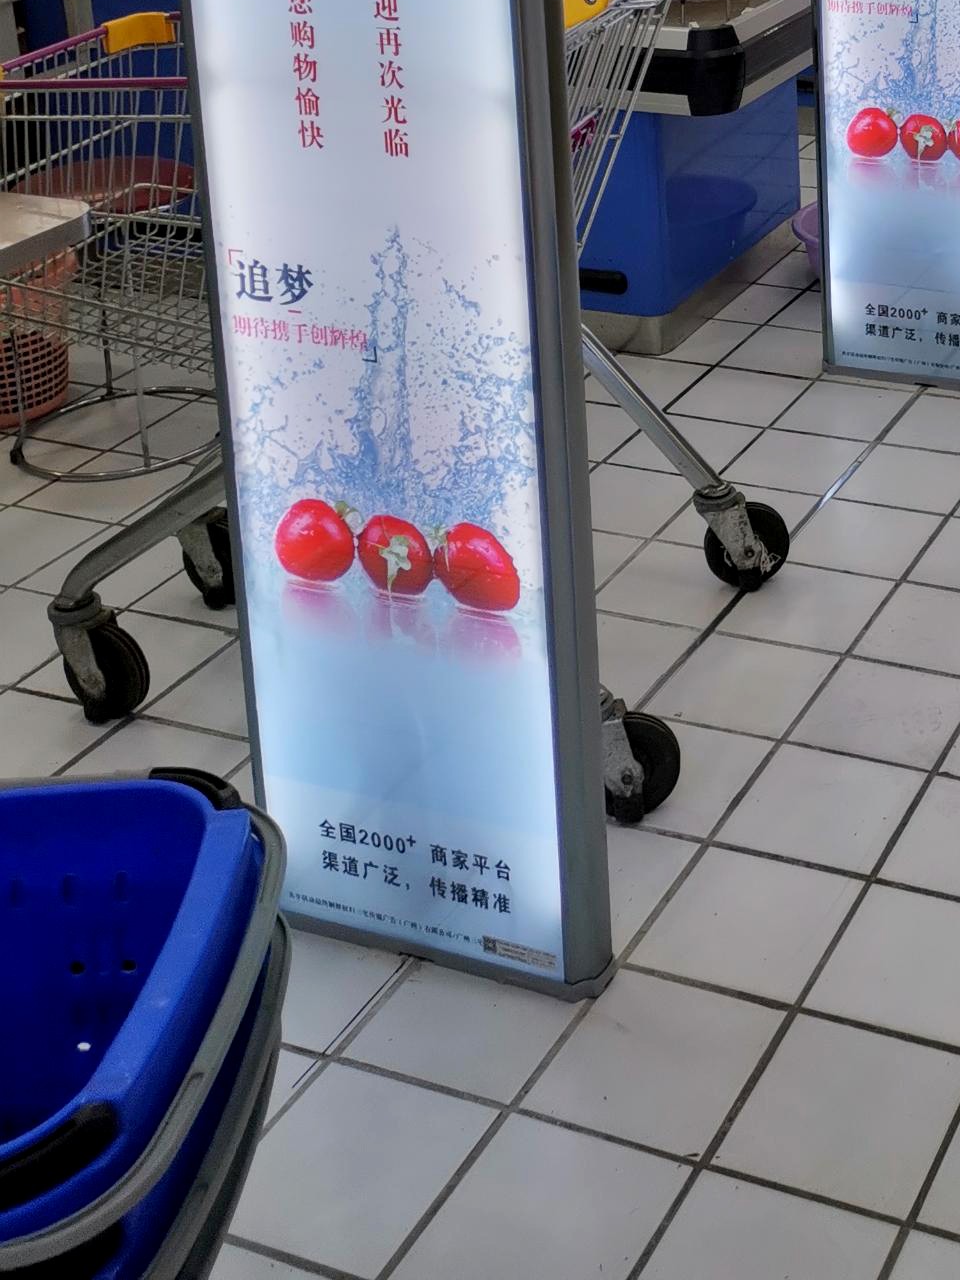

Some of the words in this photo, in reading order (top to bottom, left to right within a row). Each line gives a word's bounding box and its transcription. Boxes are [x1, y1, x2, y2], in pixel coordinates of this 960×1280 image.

[233, 259, 314, 306] 追梦
[231, 314, 369, 353] 期待携手创辉煌
[429, 842, 511, 881] 商家平台
[429, 875, 512, 914] 传播精准
